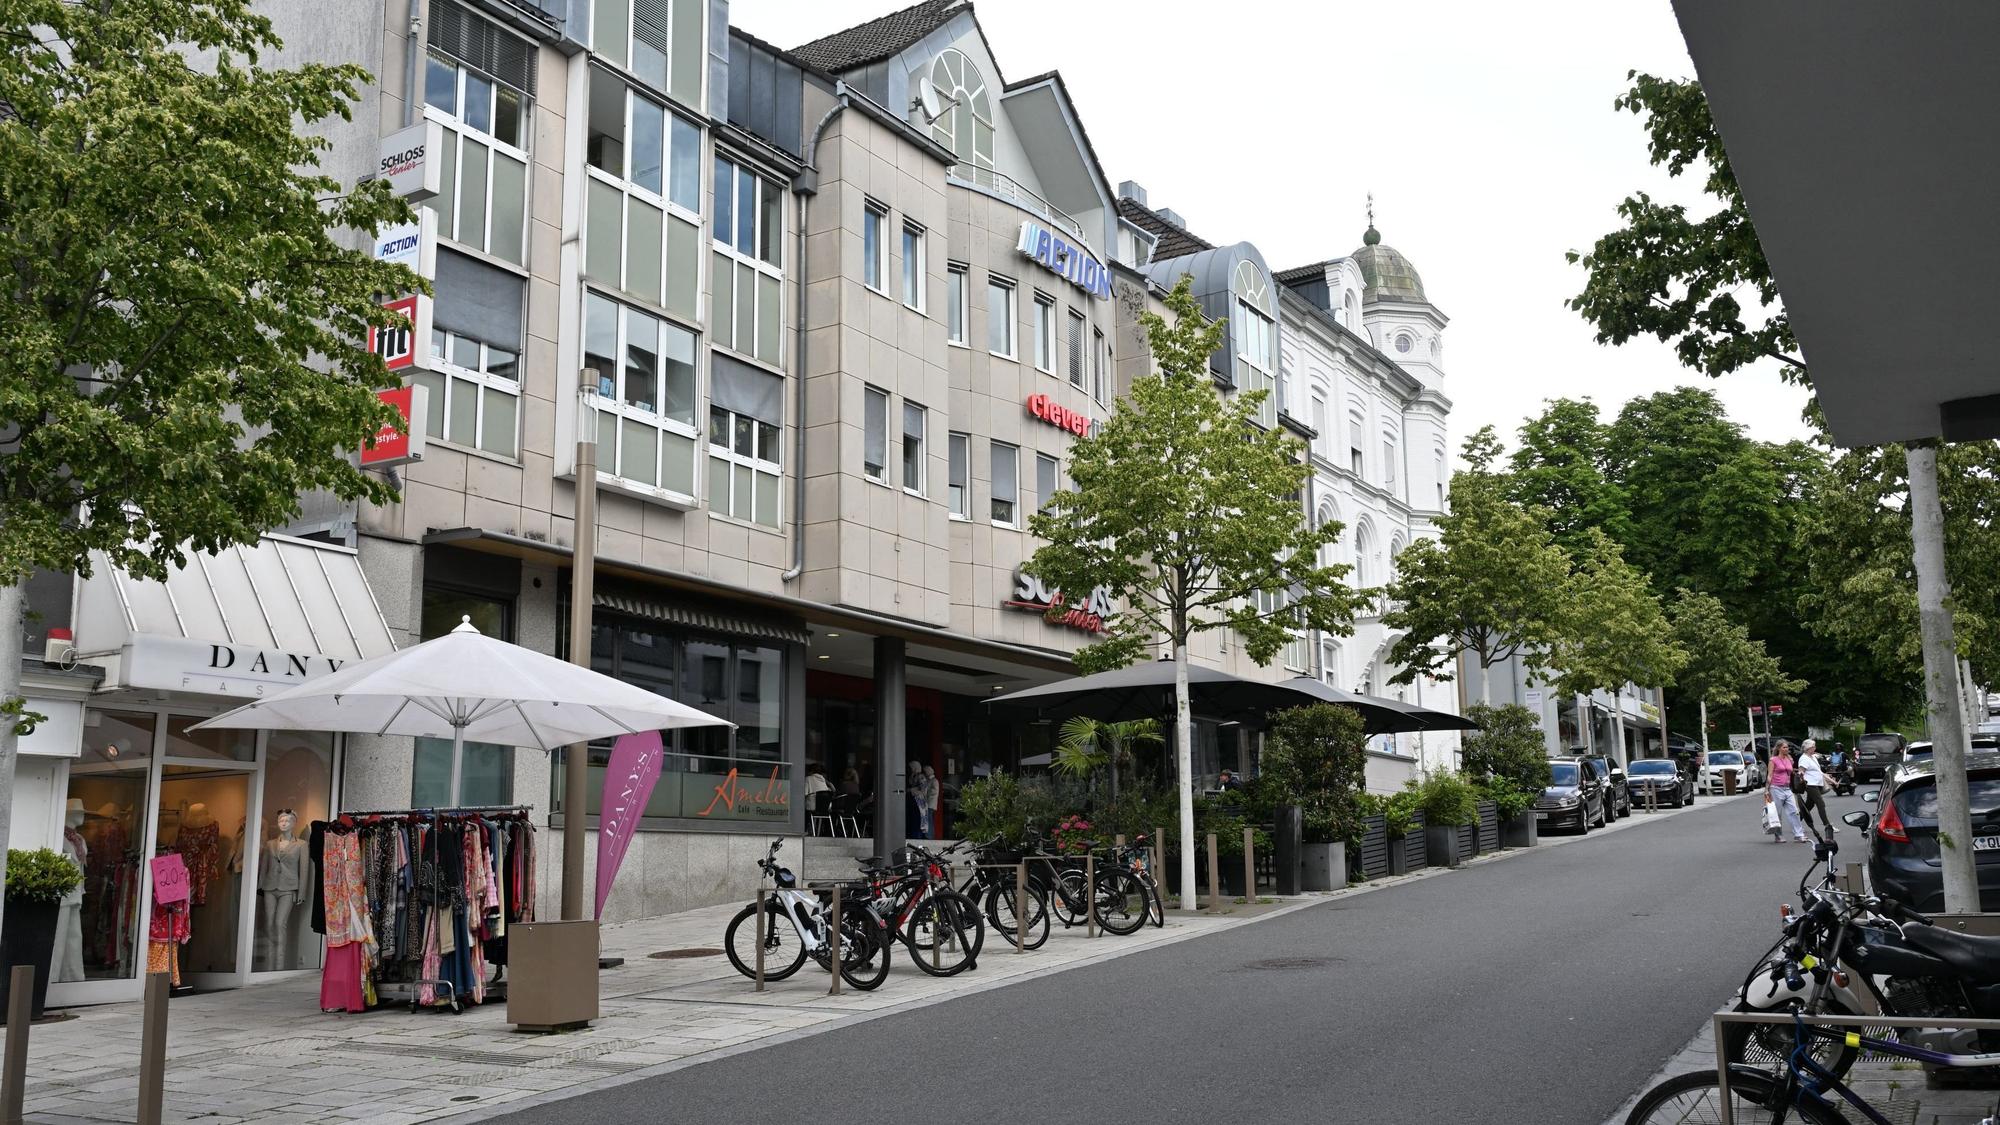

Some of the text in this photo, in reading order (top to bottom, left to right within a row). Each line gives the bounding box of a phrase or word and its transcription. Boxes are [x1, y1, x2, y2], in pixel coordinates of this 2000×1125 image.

[380, 145, 425, 171] SCHLOSS
[381, 234, 419, 257] ACTION
[1035, 229, 1112, 301] ACTION
[1027, 394, 1091, 438] clever
[755, 806, 789, 817] Restaurant
